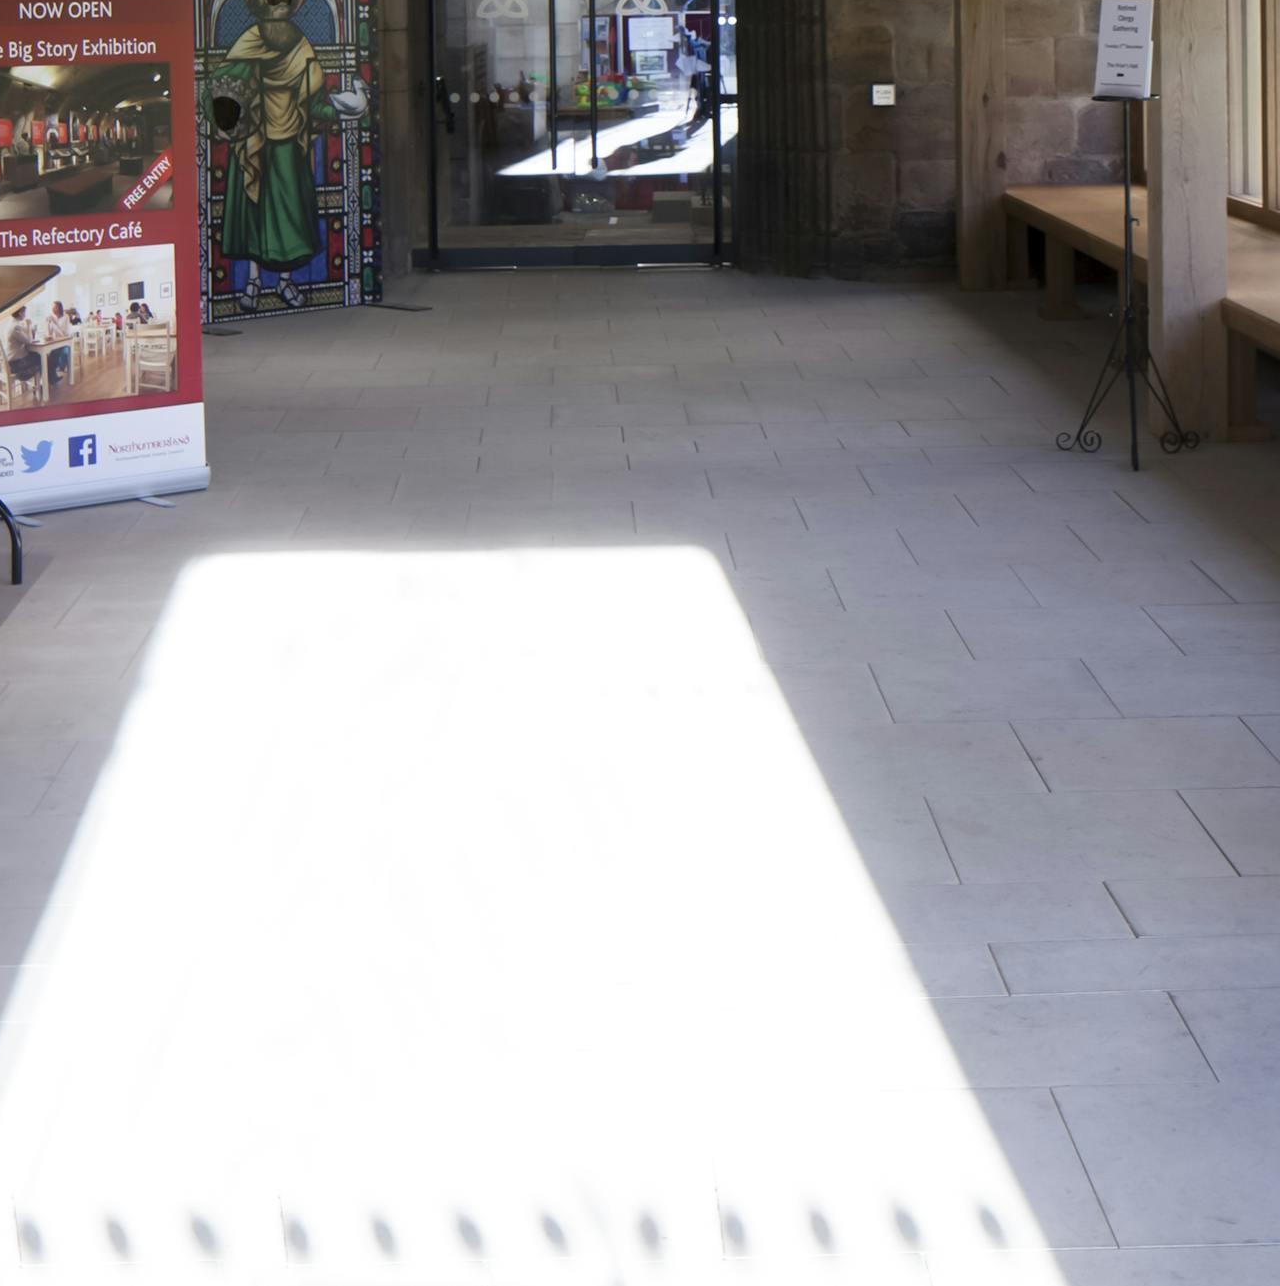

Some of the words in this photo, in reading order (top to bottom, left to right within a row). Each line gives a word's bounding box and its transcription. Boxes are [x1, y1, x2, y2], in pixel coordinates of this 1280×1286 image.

[19, 2, 64, 19] NOW
[68, 1, 113, 19] OPEN
[8, 40, 33, 63] Big
[37, 39, 78, 61] Story
[82, 37, 157, 57] Exhibition
[123, 183, 148, 210] FREE
[143, 156, 172, 188] ENTRY
[0, 230, 28, 248] The
[32, 226, 104, 246] Refectory
[108, 221, 143, 241] Café
